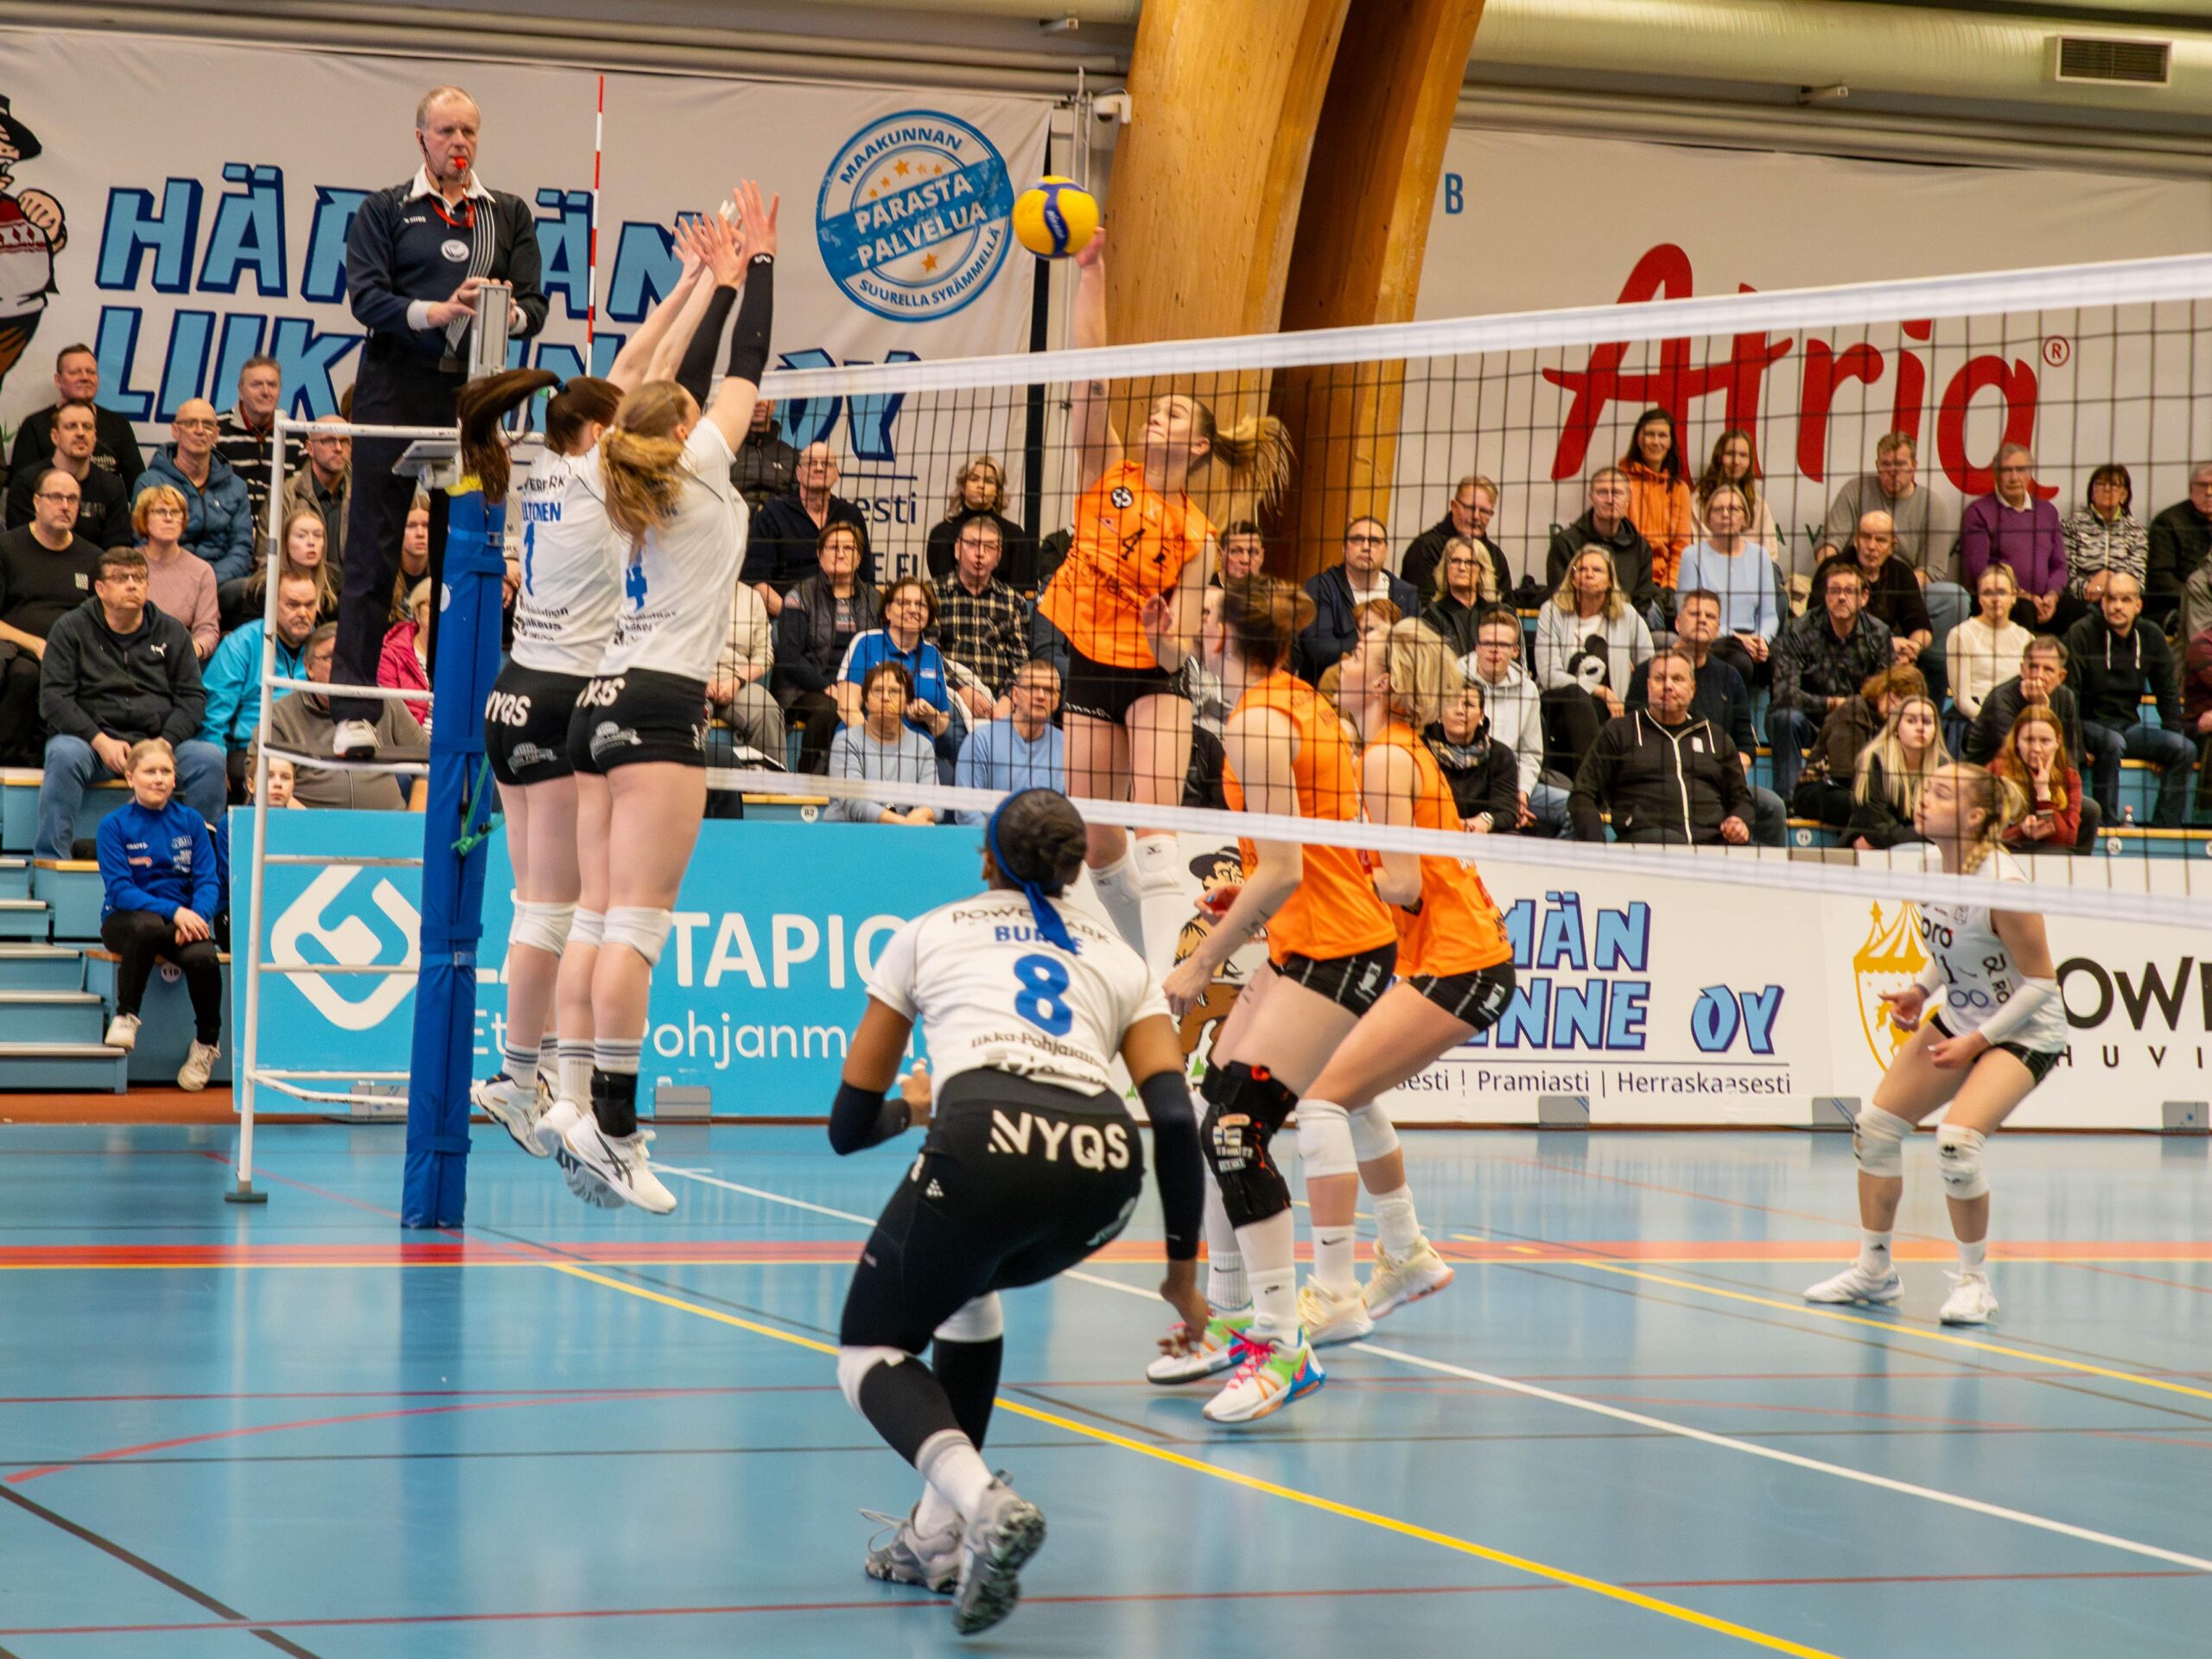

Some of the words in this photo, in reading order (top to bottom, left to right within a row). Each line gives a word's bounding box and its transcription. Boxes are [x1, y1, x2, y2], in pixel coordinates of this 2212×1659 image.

[840, 127, 963, 185] MAAKUNNAN
[855, 174, 975, 235] PARASTA
[856, 201, 988, 269] PALVELUA
[95, 162, 704, 324] HÄRÄN
[859, 279, 931, 308] SUURELLA
[932, 226, 1001, 305] SYRÄMMELLÄ
[1542, 243, 2060, 500] Atria
[853, 491, 918, 525] esti
[952, 906, 1112, 945] POWEARK
[995, 925, 1084, 957] BUE
[1014, 954, 1072, 1037] 8
[1457, 977, 1651, 1052] NNE
[1690, 983, 1785, 1056] OY
[1478, 1070, 1591, 1094] Pramiasti
[1618, 1070, 1792, 1096] Herraskaasesti
[988, 1109, 1130, 1173] NYQS
